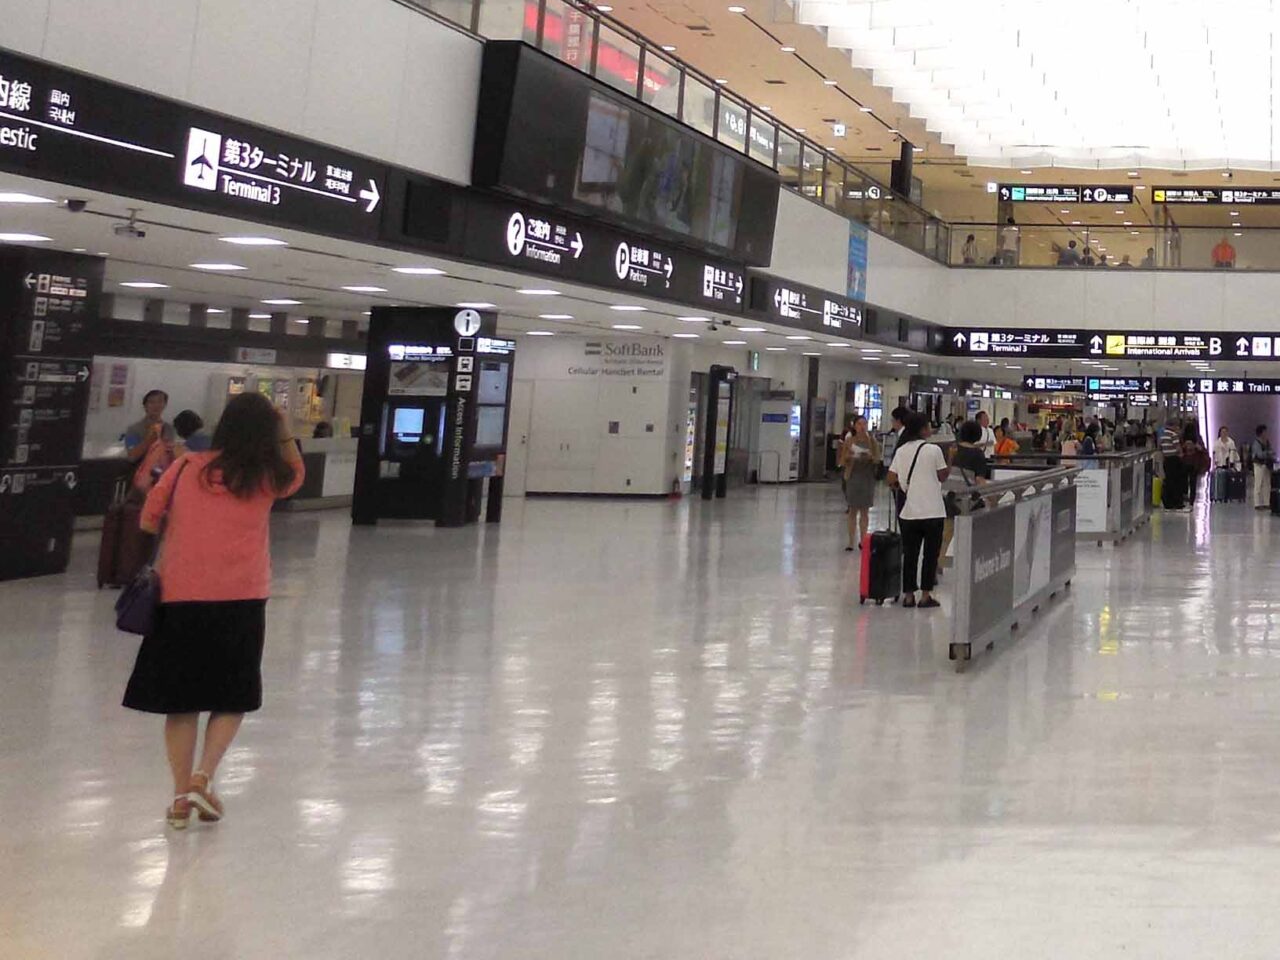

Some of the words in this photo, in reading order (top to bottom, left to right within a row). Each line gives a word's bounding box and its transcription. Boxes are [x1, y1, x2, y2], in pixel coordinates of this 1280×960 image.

[223, 138, 316, 183] 第3ターミナル
[221, 175, 271, 203] Terminal
[272, 187, 281, 205] 3
[527, 218, 551, 241] ご案内
[526, 244, 561, 265] Information
[629, 268, 648, 287] Parking
[991, 333, 1049, 343] 第3ターミナル
[1209, 337, 1222, 355] B
[605, 343, 664, 356] SoftBank
[991, 345, 1022, 353] Terminal
[1022, 345, 1028, 353] 3
[568, 366, 598, 375] Cellular
[601, 366, 635, 376] Handset
[637, 367, 664, 376] Rental
[1248, 382, 1270, 392] Train
[456, 397, 466, 426] Access
[452, 426, 463, 480] Information
